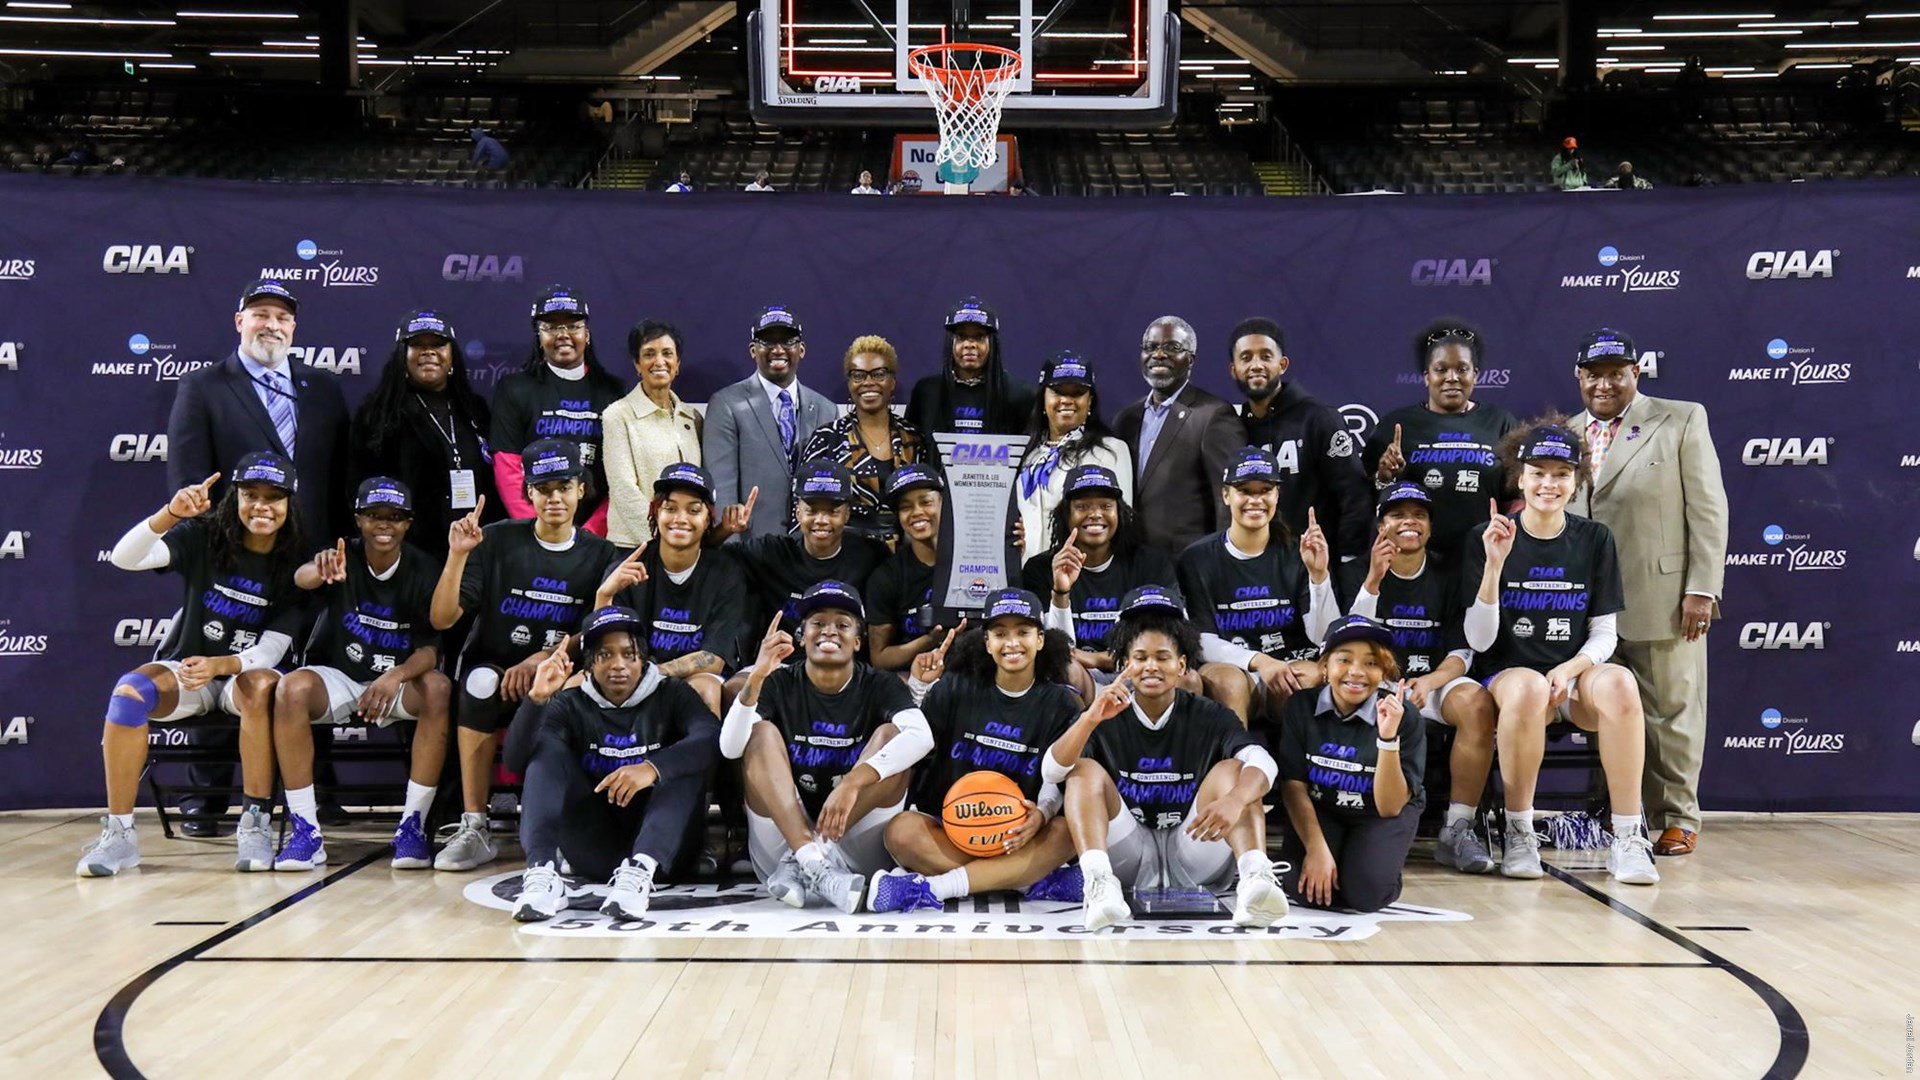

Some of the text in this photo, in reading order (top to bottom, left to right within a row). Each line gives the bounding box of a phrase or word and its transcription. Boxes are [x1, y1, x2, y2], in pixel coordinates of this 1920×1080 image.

[814, 76, 861, 93] CIAA
[778, 96, 817, 105] SPALDING
[0, 259, 35, 280] URS
[103, 245, 190, 274] CIAA
[442, 254, 524, 282] CIAA
[1746, 250, 1833, 279] CIAA
[260, 260, 379, 287] MAKE IT YOURS
[1410, 259, 1493, 286] CIAA
[1561, 265, 1681, 292] MAKE IT YOURS
[92, 363, 135, 375] MAKE
[137, 363, 152, 375] IT
[1396, 369, 1511, 389] MA URS
[1729, 357, 1851, 385] MAKE IT YOURS
[560, 400, 591, 411] CIAA
[536, 418, 596, 436] CHAMPIO
[1438, 432, 1473, 441] CIAA
[110, 434, 168, 461] CIA
[951, 443, 1010, 467] CIAA
[1742, 437, 1828, 466] CIAA
[0, 449, 43, 469] URS
[1410, 449, 1495, 467] CHAMPIONS
[953, 480, 1007, 489] WOMEN'S BASKETBALL
[1725, 544, 1847, 571] MAKE IT YOURS
[959, 564, 999, 574] CHAMPION
[1529, 566, 1565, 578] CIAA
[532, 576, 568, 592] CIAA
[1235, 585, 1270, 598] CIAA
[202, 590, 262, 624] CHAMPIO
[500, 597, 573, 623] CHAMPIO
[1236, 600, 1274, 608] CONFERENCE
[1501, 590, 1589, 611] CHAMPIONS
[114, 618, 173, 646] CIA
[1391, 619, 1427, 627] CONFERENCE
[1739, 622, 1824, 650] CIAA
[1896, 640, 1920, 652] MA
[812, 721, 846, 736] CIAA
[985, 721, 1022, 738] CIAA
[982, 737, 1023, 750] CONFERENCE
[1724, 727, 1845, 755] MAKE IT YOURS
[1317, 757, 1358, 771] CONFERENCE
[1136, 773, 1176, 781] CONFERENCE
[1308, 766, 1373, 793] AMPION
[955, 801, 1013, 820] Wilson
[550, 917, 1352, 938] 50th Anniversary
